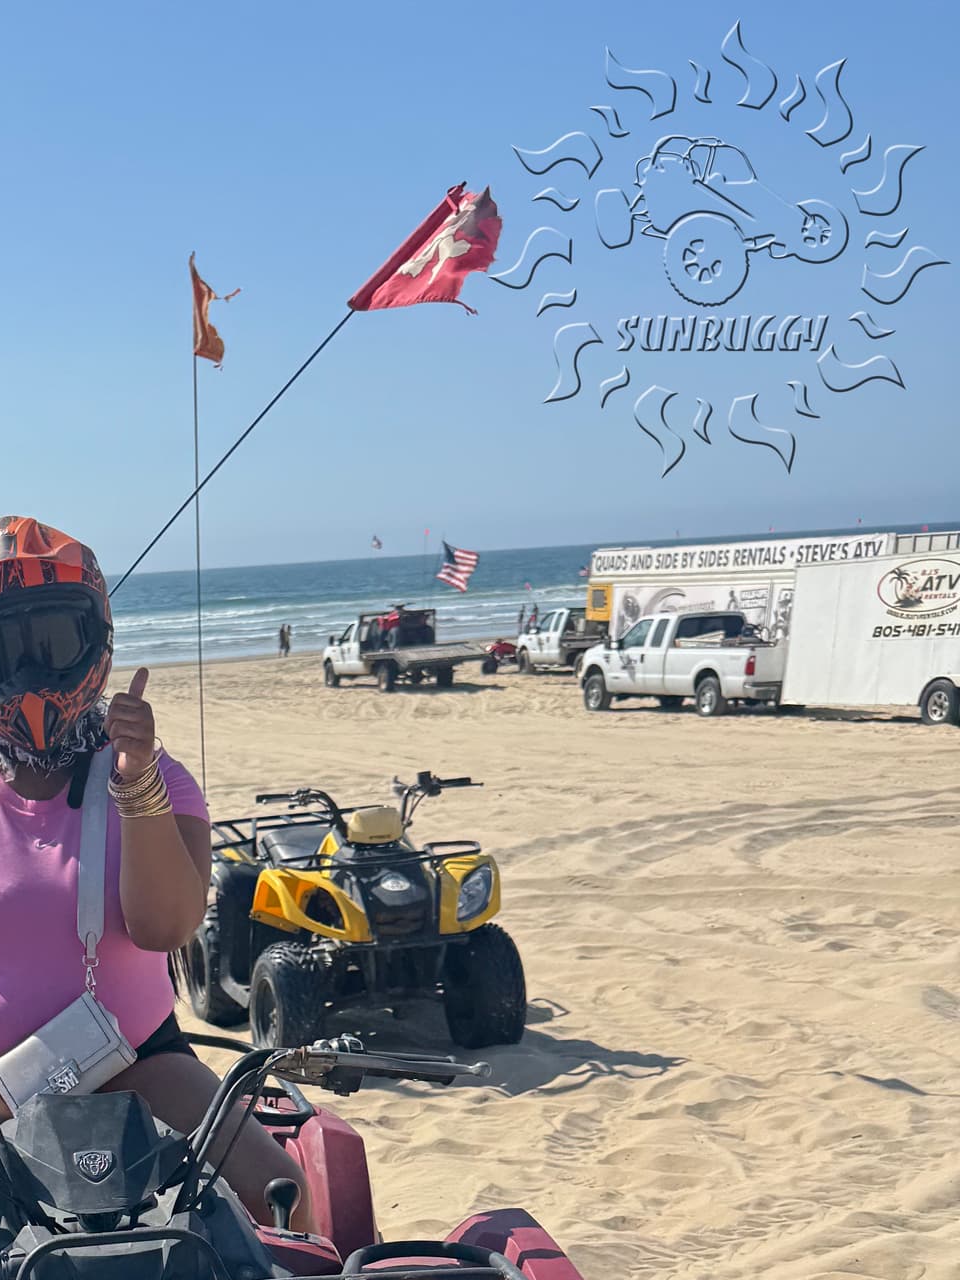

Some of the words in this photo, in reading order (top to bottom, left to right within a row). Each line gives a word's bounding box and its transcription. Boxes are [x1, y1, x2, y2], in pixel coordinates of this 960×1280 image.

[595, 554, 628, 572] QUADS
[629, 554, 653, 571] AND
[654, 552, 679, 570] SIDE
[680, 551, 697, 568] BY
[698, 549, 730, 568] SIDES
[733, 546, 787, 567] RENTALS
[795, 542, 849, 564] STEVE'S
[853, 539, 883, 560] ATV
[920, 574, 960, 592] ATV
